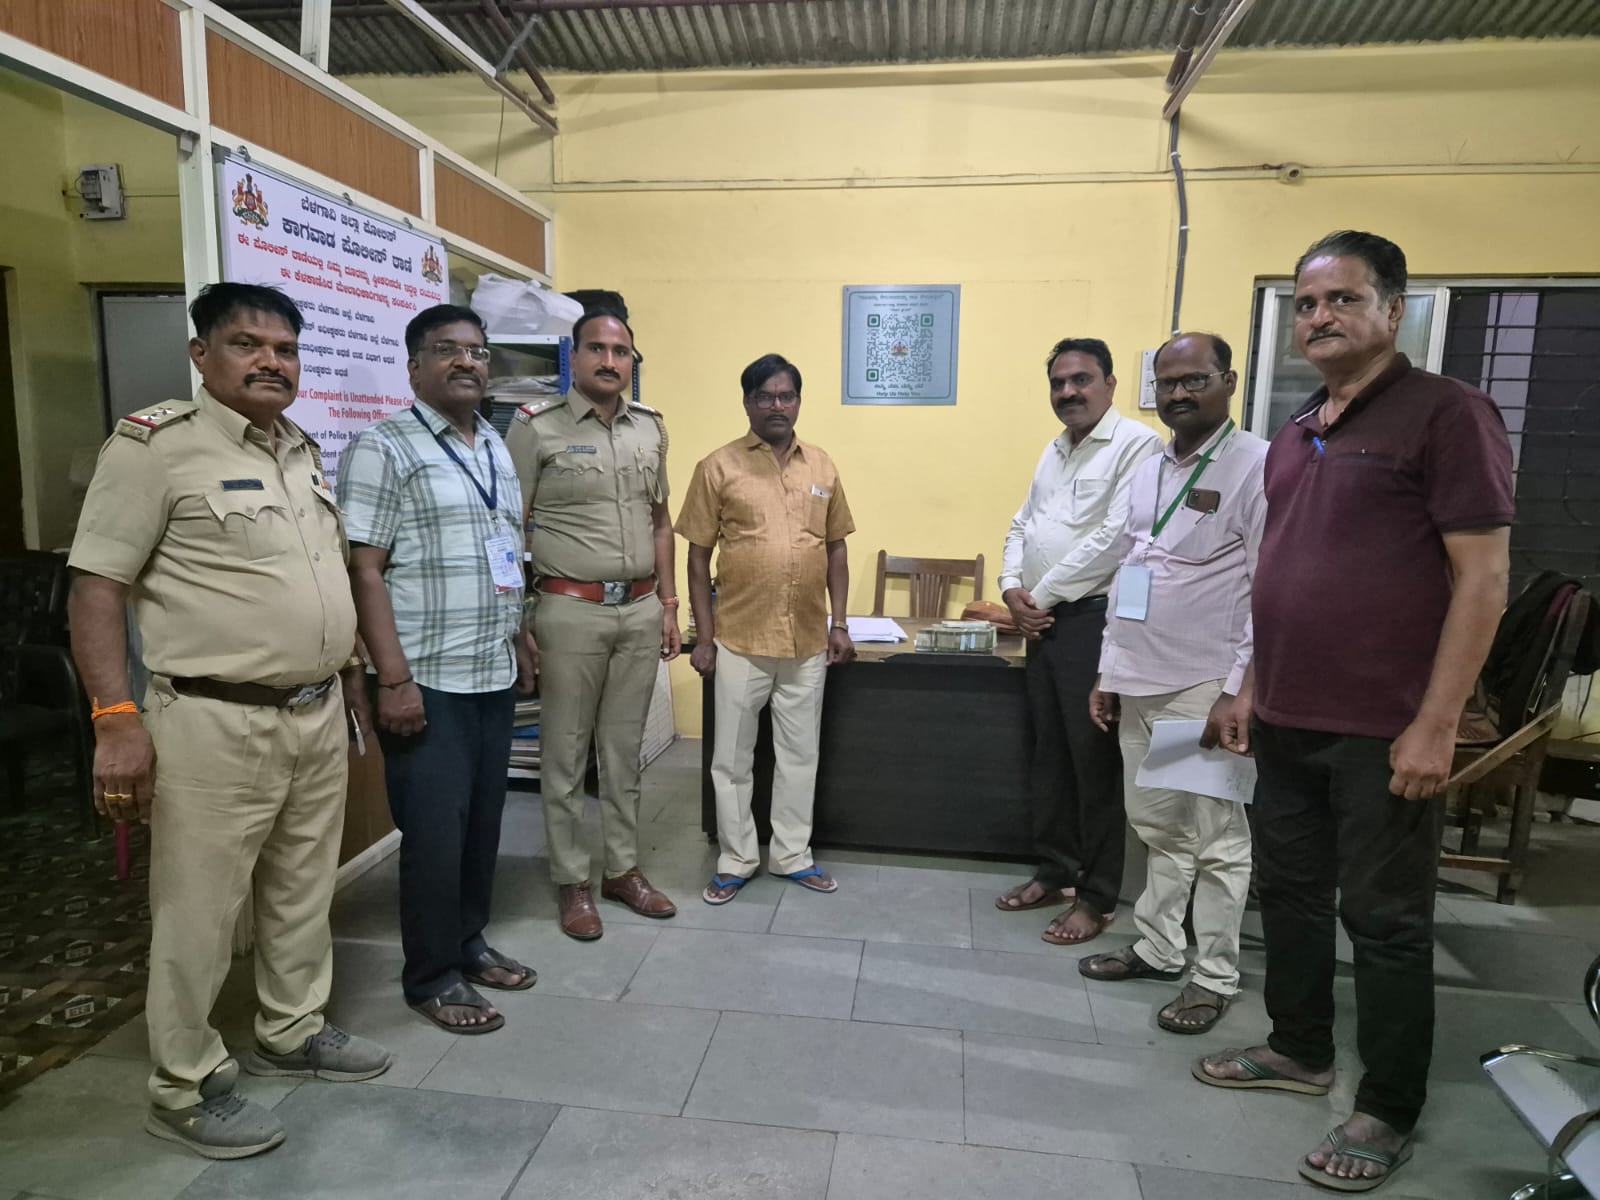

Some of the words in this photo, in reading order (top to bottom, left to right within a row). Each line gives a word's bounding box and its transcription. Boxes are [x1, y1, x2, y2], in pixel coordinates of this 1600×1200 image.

[301, 196, 336, 221] ಬೆಳಗಾವಿ
[341, 213, 360, 234] ಜಿಲ್ಲಾ
[238, 233, 250, 246] ಈ
[282, 218, 336, 248] ಕಾಗವಾಡ
[281, 268, 290, 278] ಈ
[296, 390, 308, 398] our
[309, 388, 342, 402] Complaint
[344, 391, 349, 401] is
[350, 392, 384, 404] Unattended
[386, 395, 402, 406] Please
[328, 407, 340, 418] The
[342, 408, 372, 422] Following
[320, 430, 327, 440] of
[329, 430, 347, 440] Police
